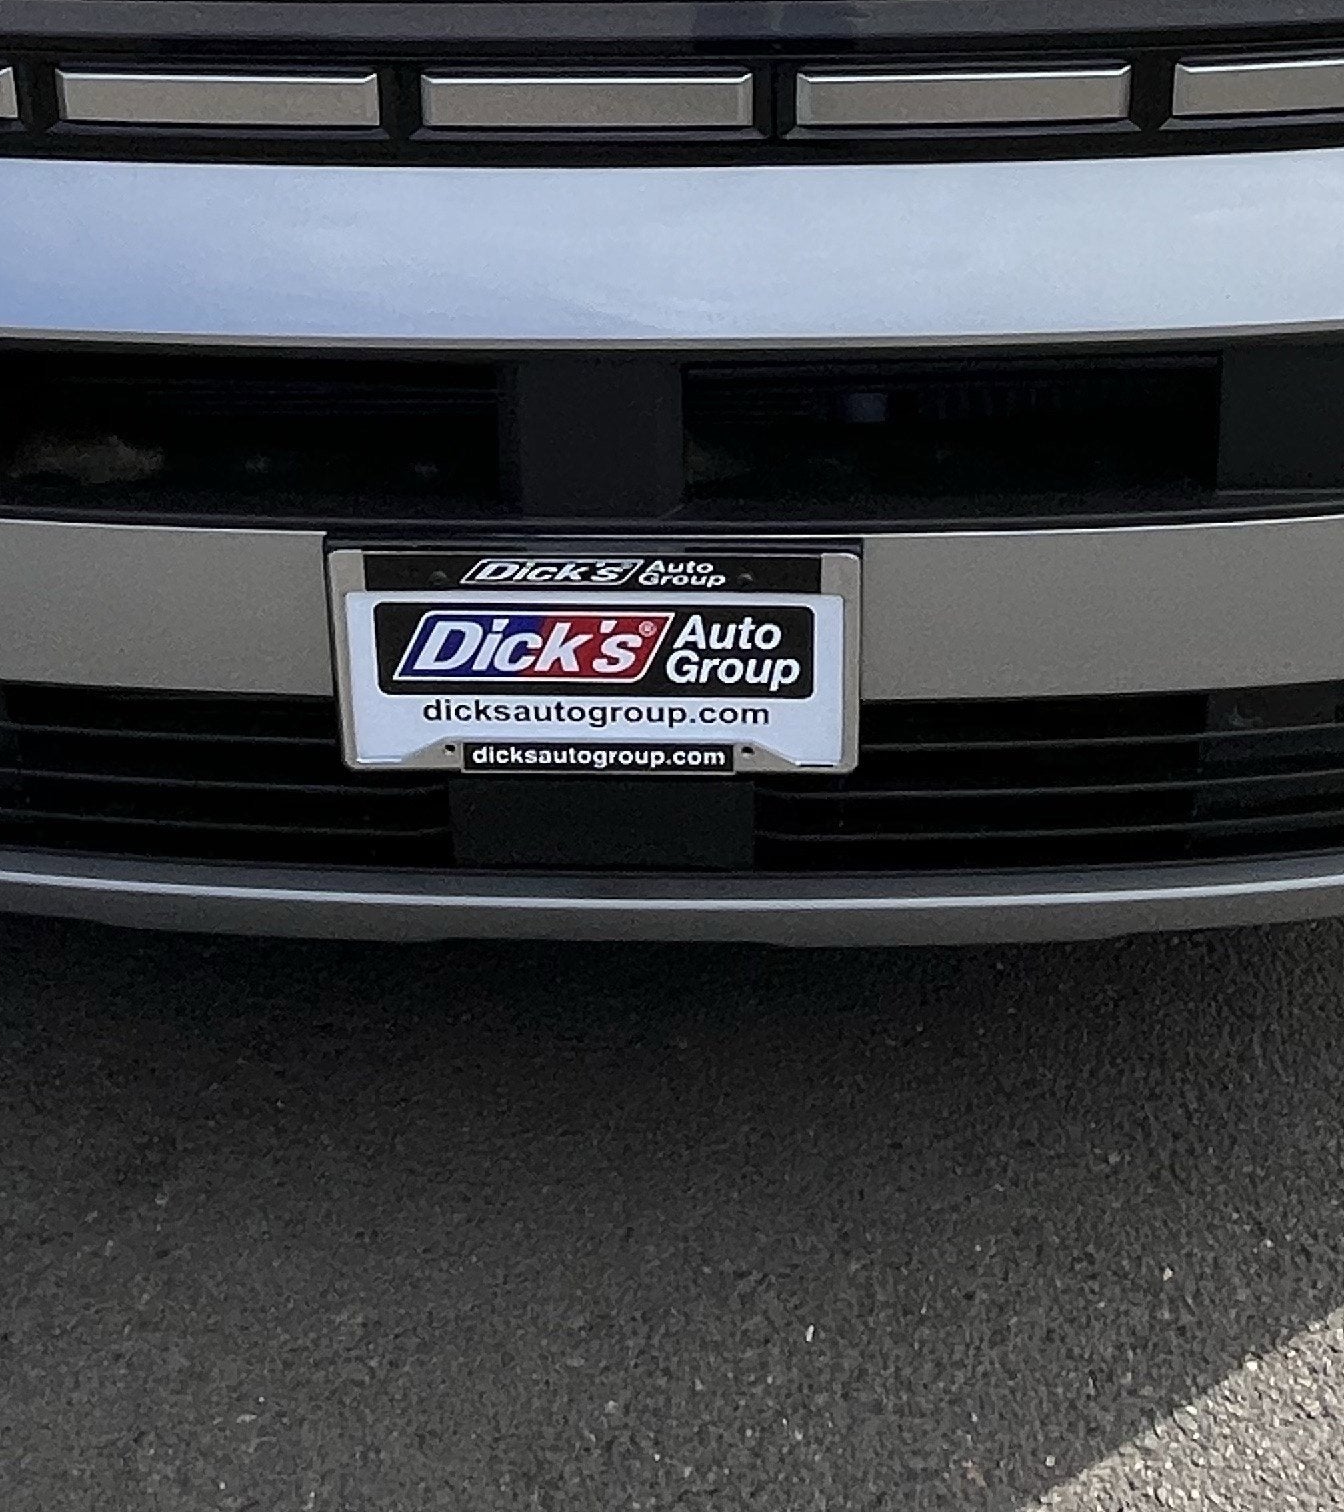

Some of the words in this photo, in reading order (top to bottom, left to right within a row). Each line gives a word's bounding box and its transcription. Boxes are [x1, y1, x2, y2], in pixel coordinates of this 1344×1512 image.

[474, 560, 624, 582] Dick's
[646, 560, 713, 574] Auto
[639, 572, 726, 588] Group
[673, 615, 782, 650] Auto
[413, 618, 643, 674] Dick's
[666, 650, 800, 691] Group
[423, 699, 770, 727] dicksautogroup.com
[472, 746, 725, 767] dicksautogroup.com
